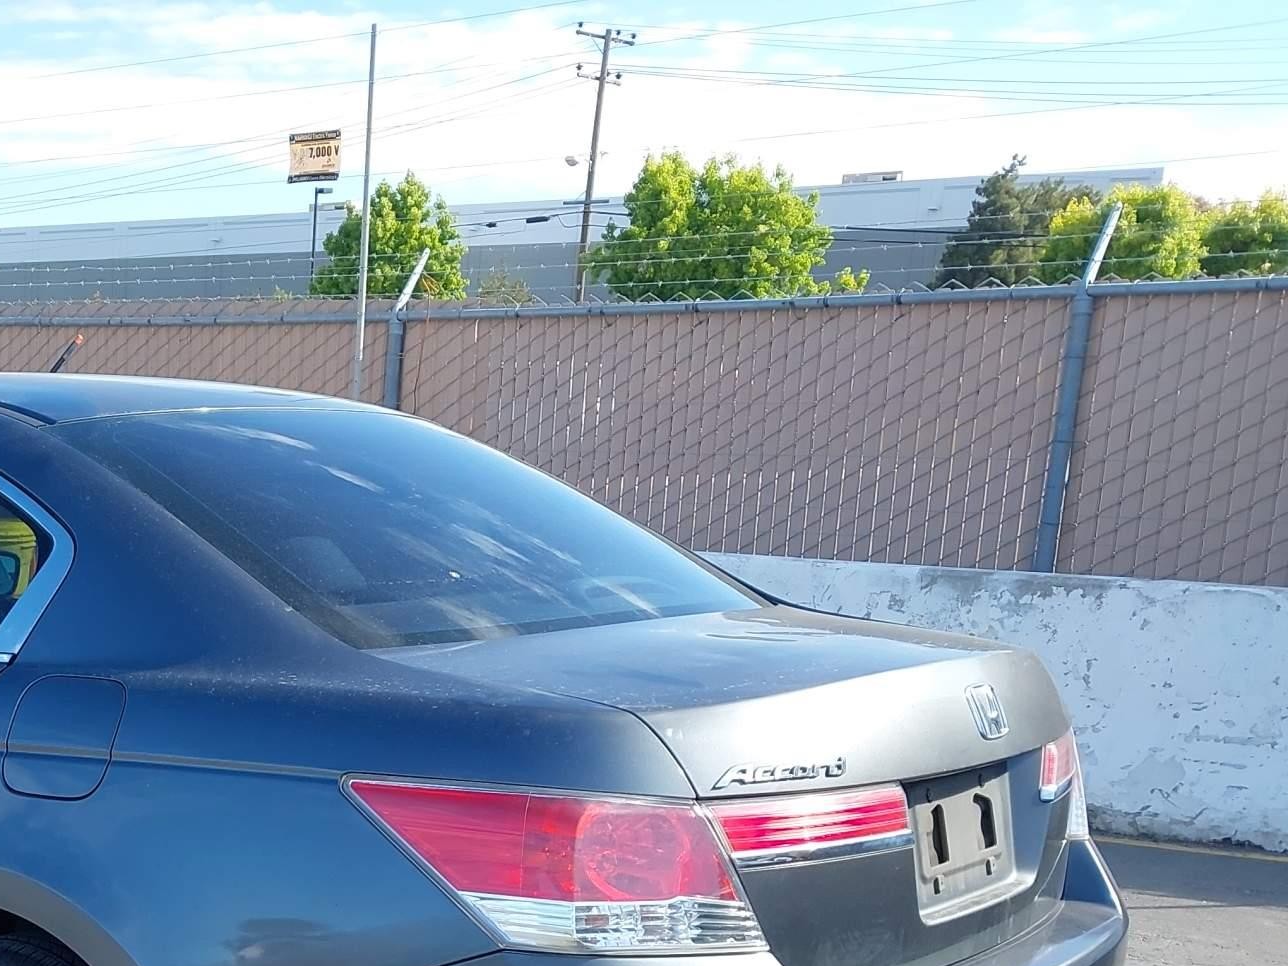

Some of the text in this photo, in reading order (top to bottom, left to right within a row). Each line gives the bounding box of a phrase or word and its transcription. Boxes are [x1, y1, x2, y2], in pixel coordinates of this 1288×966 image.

[309, 144, 340, 159] 7,000 V
[711, 756, 846, 791] Accord
